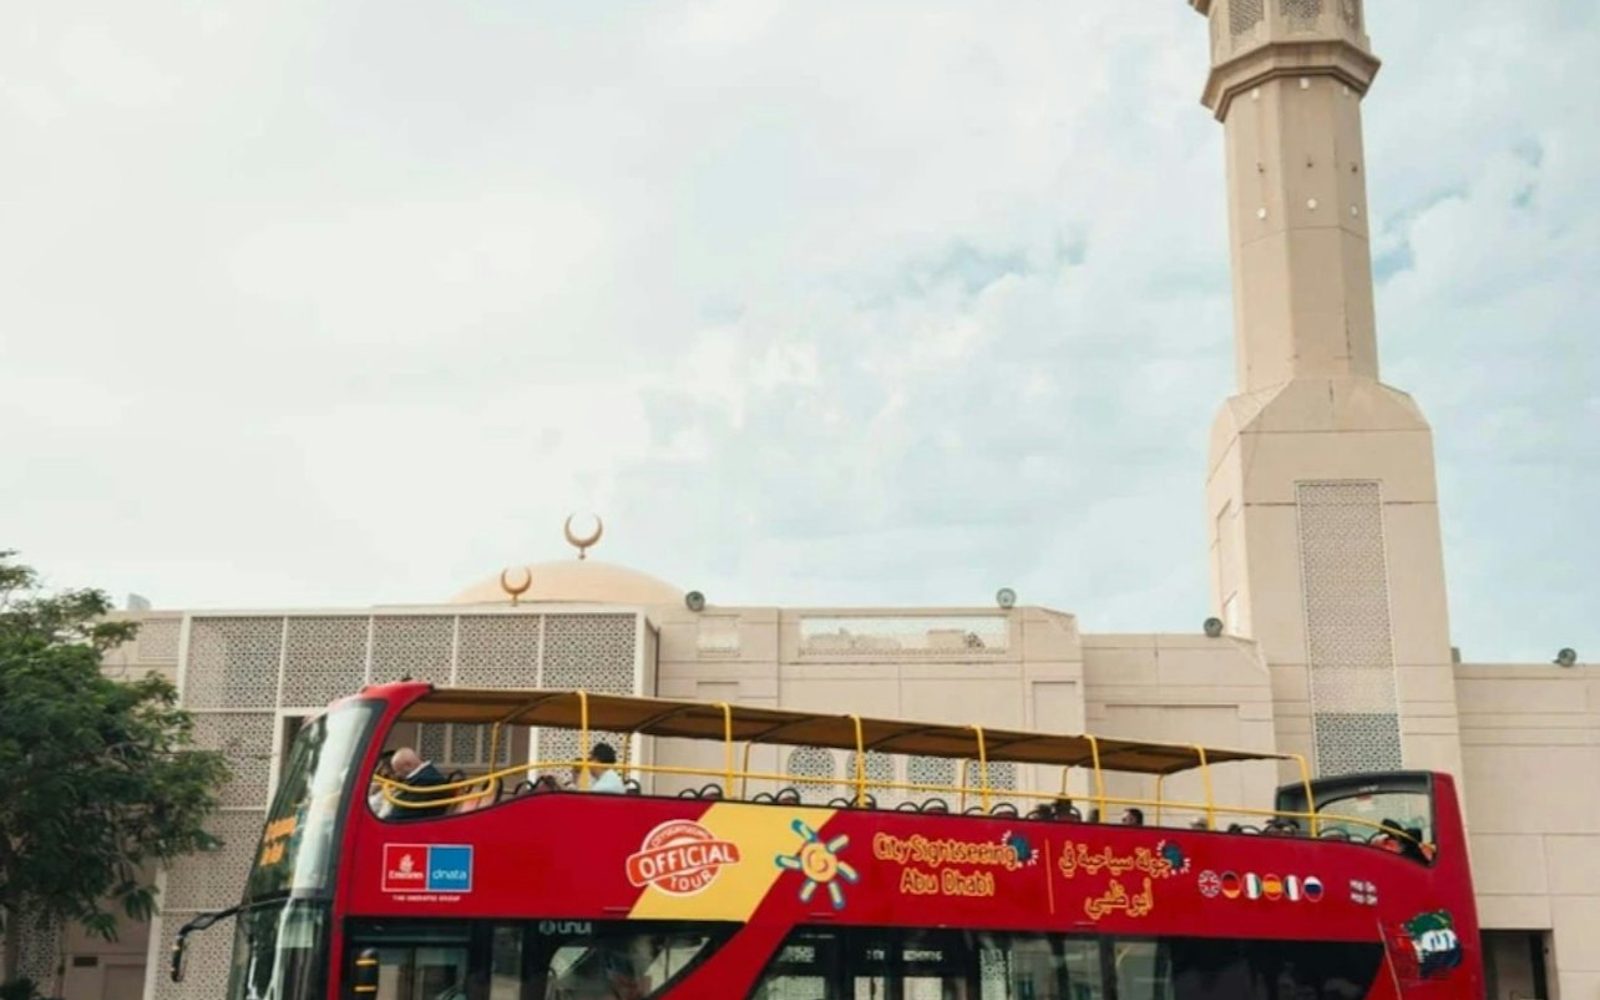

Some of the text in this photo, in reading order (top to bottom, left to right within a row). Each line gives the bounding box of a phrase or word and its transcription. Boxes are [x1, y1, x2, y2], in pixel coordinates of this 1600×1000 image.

[432, 868, 467, 880] dnata
[638, 844, 735, 879] OFFICIAL
[670, 869, 713, 891] TOUR
[900, 867, 995, 897] Abu Dhabi
